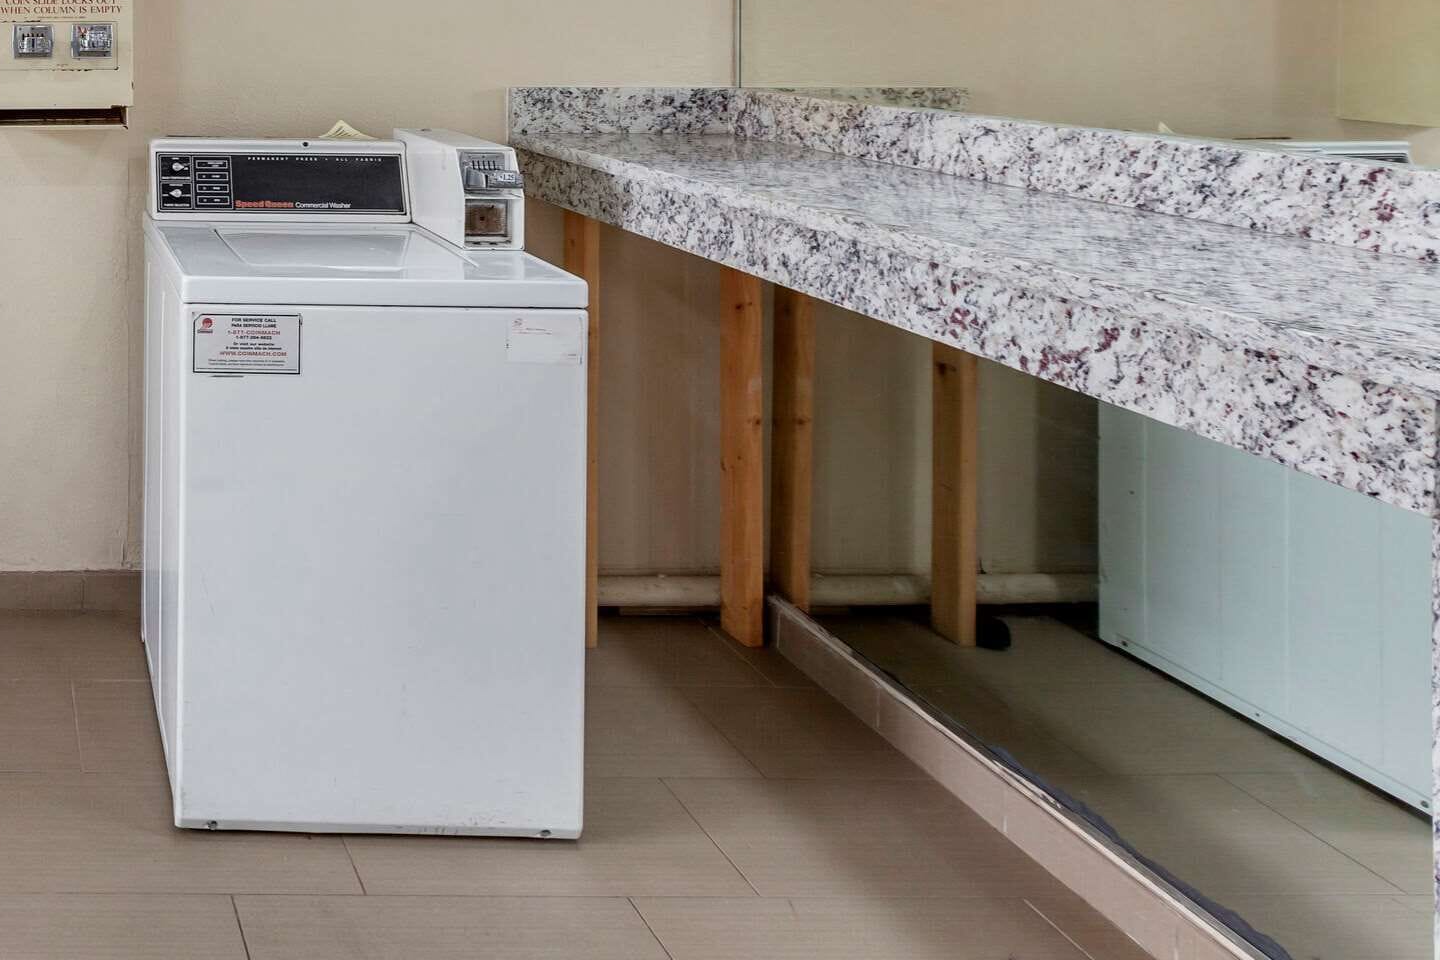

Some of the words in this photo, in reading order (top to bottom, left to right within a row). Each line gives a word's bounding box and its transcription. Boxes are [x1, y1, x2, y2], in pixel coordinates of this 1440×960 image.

[1, 6, 30, 14] WHEN
[33, 6, 75, 14] COLUMN
[90, 5, 122, 14] EMPTY
[235, 200, 265, 209] Speed
[295, 201, 328, 209] Commercial
[329, 201, 351, 209] Washer
